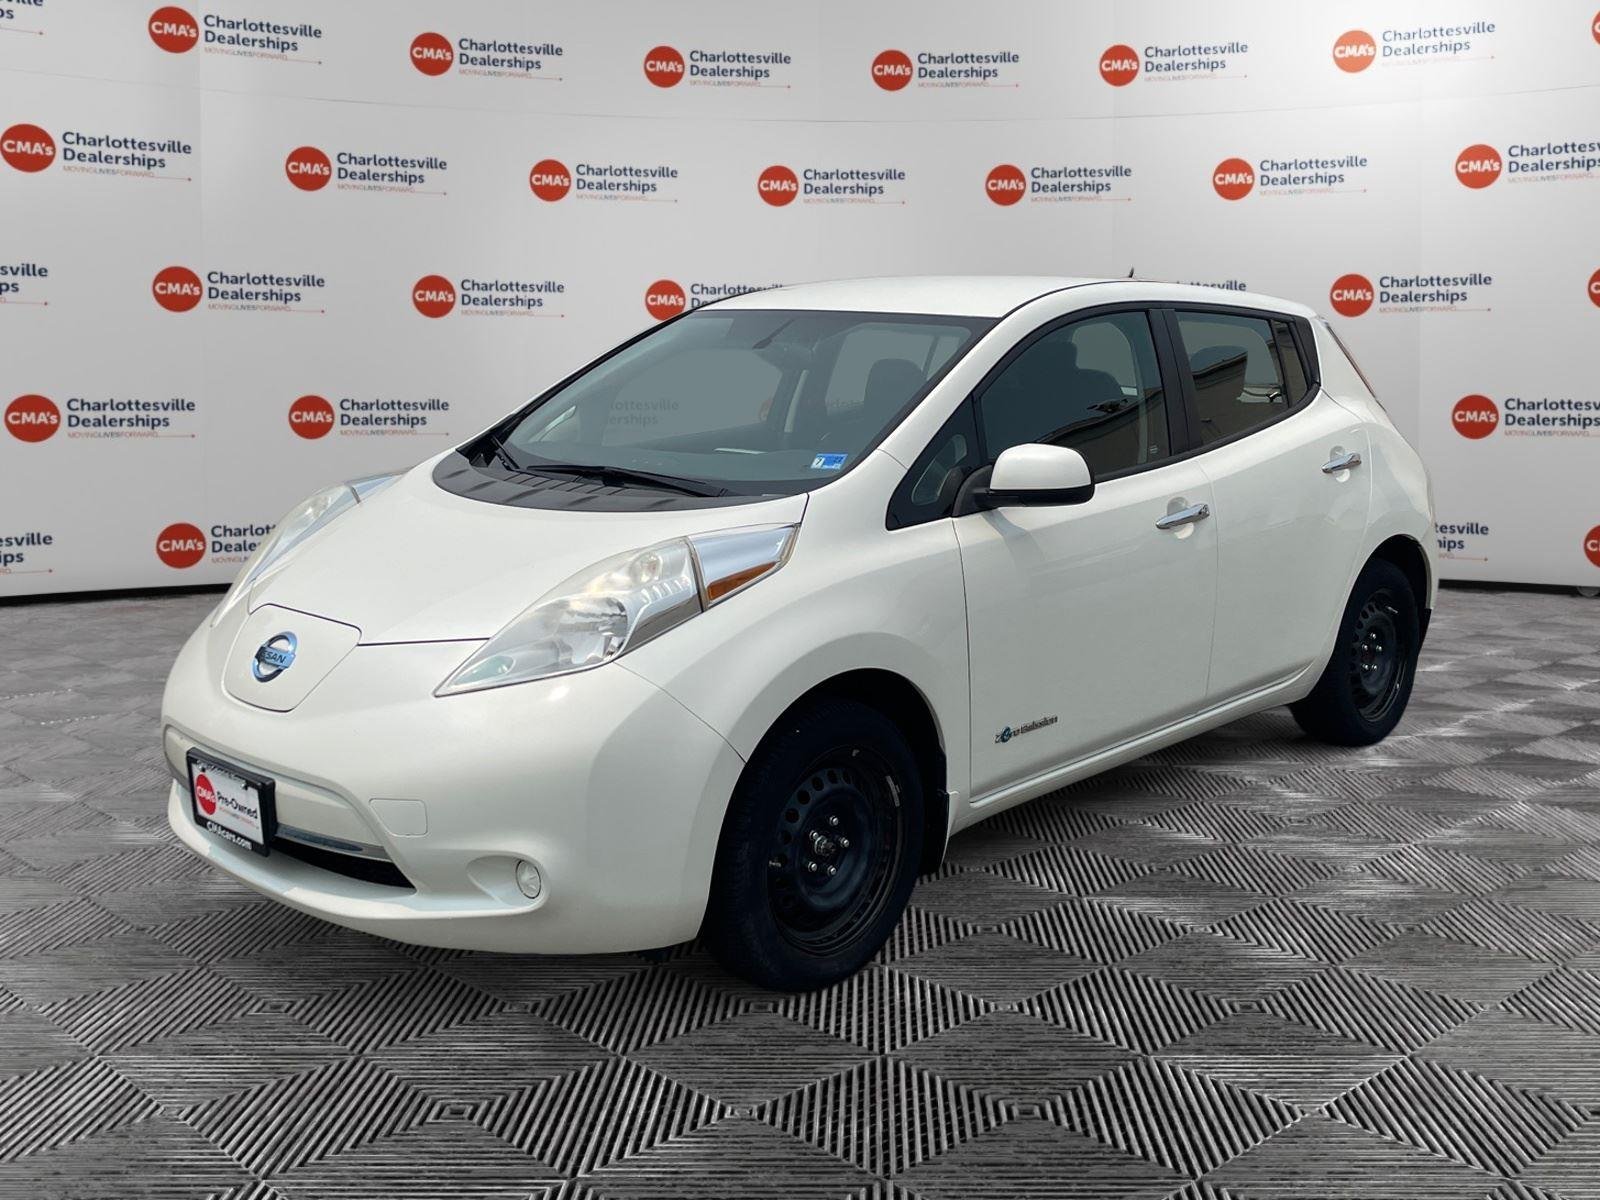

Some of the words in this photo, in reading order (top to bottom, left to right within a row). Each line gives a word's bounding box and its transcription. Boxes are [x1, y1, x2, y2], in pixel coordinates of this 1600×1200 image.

[151, 22, 197, 38] CMA's
[204, 14, 323, 39] Charlottesville
[1382, 21, 1496, 42] Charlottesville
[204, 30, 299, 53] Dealerships
[458, 38, 563, 56] Charlottesville
[1382, 40, 1471, 58] Dealerships
[412, 47, 452, 61] CMA's
[689, 50, 791, 65] Charlottesville
[1144, 42, 1249, 58] Charlottesville
[1334, 44, 1376, 59] CMA's
[458, 53, 542, 72] Dealerships
[917, 52, 1020, 65] Charlottesville
[1101, 58, 1138, 71] CMA's
[1144, 58, 1226, 73] Dealerships
[646, 60, 684, 73] CMA's
[689, 65, 770, 80] Dealerships
[873, 65, 912, 76] CMA's
[917, 67, 999, 81] Dealerships
[3, 140, 54, 156] CMA's
[62, 131, 192, 154] Charlottesville
[62, 147, 166, 170] Dealerships
[337, 152, 448, 171] Charlottesville
[1260, 155, 1368, 171] Charlottesville
[1456, 158, 1501, 174] CMA's
[287, 162, 330, 176] CMA's
[576, 164, 679, 179] Charlottesville
[803, 169, 906, 181] Charlottesville
[1030, 165, 1132, 179] Charlottesville
[337, 167, 425, 187] Dealerships
[531, 173, 570, 187] CMA's
[1214, 172, 1253, 185] CMA's
[1260, 172, 1345, 187] Dealerships
[576, 179, 658, 194] Dealerships
[759, 180, 798, 192] CMA's
[803, 183, 885, 197] Dealerships
[987, 179, 1025, 191] CMA's
[1031, 181, 1112, 195] Dealerships
[207, 270, 325, 288] Charlottesville
[461, 279, 564, 294] Charlottesville
[1380, 273, 1492, 289] Charlottesville
[155, 281, 201, 296] CMA's
[208, 286, 301, 304] Dealerships
[414, 289, 454, 303] CMA's
[1331, 289, 1373, 302] CMA's
[462, 294, 543, 310] Dealerships
[647, 294, 685, 307] CMA's
[1379, 289, 1467, 305] Dealerships
[67, 398, 196, 412] Charlottesville
[339, 399, 450, 412] Charlottesville
[8, 411, 59, 425] CMA's
[67, 414, 170, 431] Dealerships
[290, 410, 333, 423] CMA's
[340, 414, 428, 430] Dealerships
[1453, 410, 1497, 423] CMA's
[158, 539, 205, 553] CMA's
